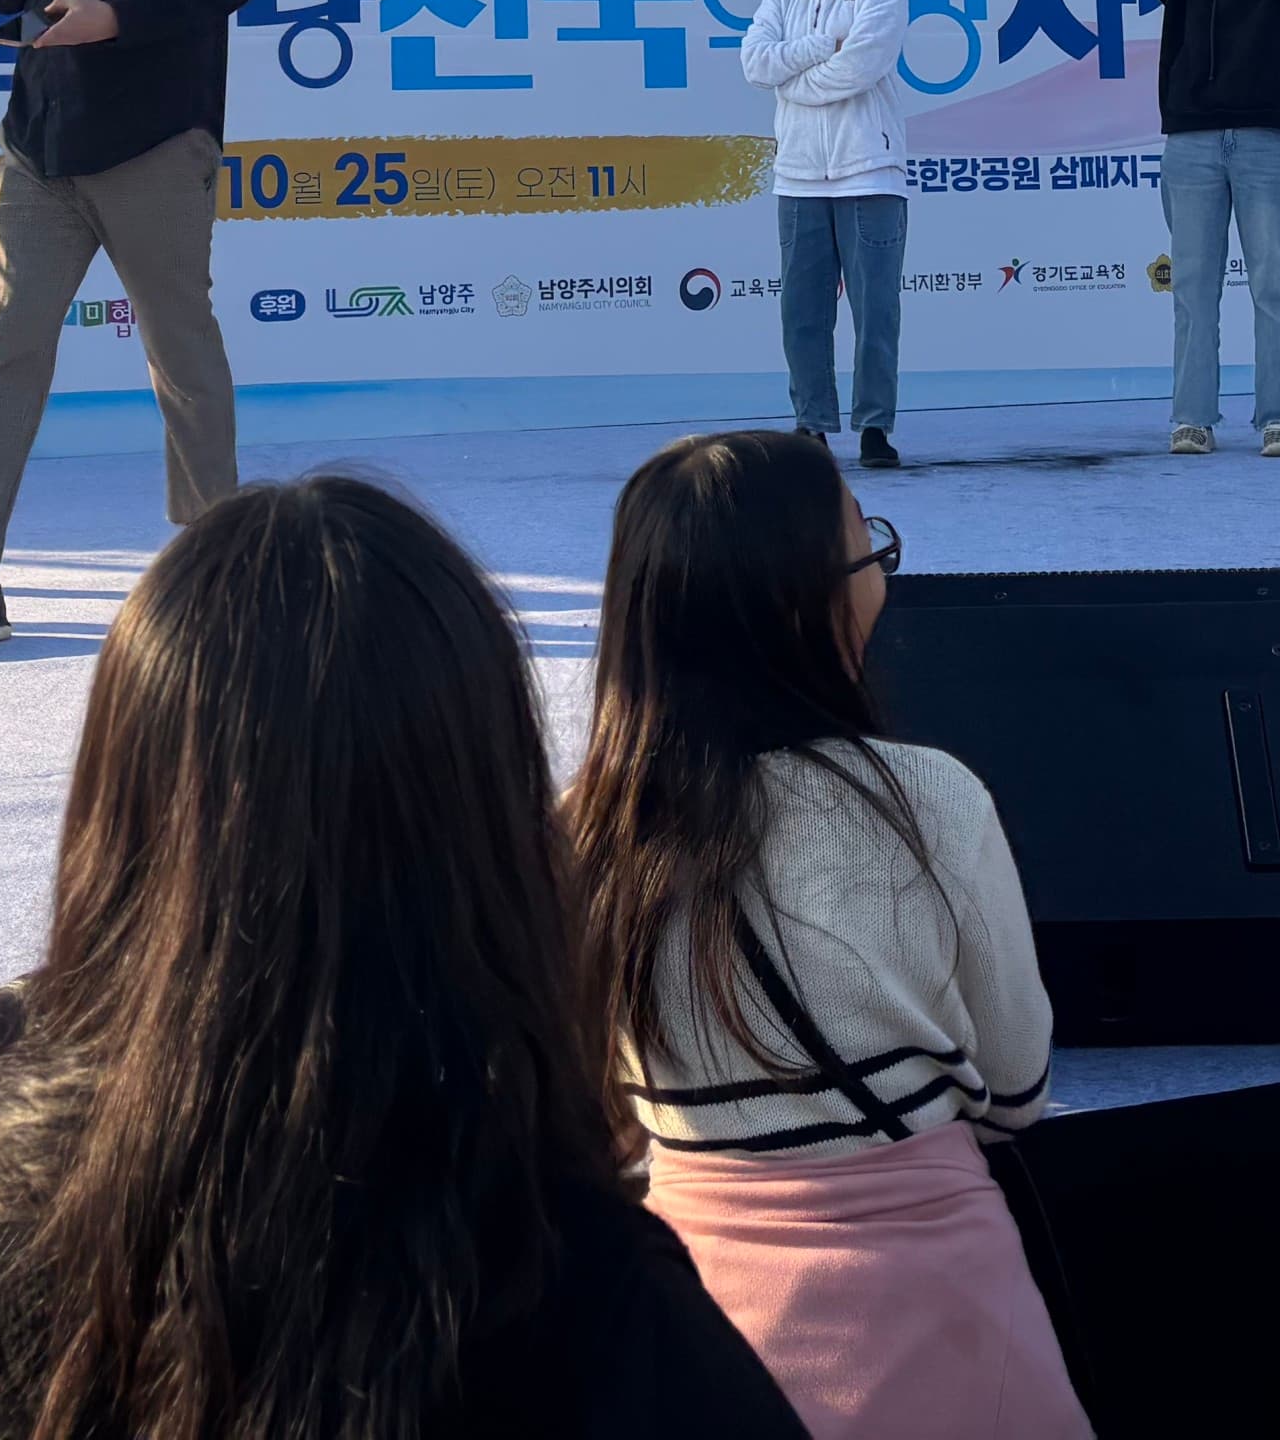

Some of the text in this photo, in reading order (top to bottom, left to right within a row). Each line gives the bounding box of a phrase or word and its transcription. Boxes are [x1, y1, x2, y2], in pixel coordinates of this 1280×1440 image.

[222, 152, 647, 208] 10월 25일(토) 오전 11시
[902, 272, 983, 293] 너지환경부
[1032, 263, 1126, 283] 경기도교육청
[419, 283, 476, 306] 남양주
[538, 276, 652, 301] 남양주시의회
[730, 278, 782, 297] 교육부
[258, 294, 297, 316] 후원
[538, 298, 652, 312] NAMYANGJU CITY COUNCIL
